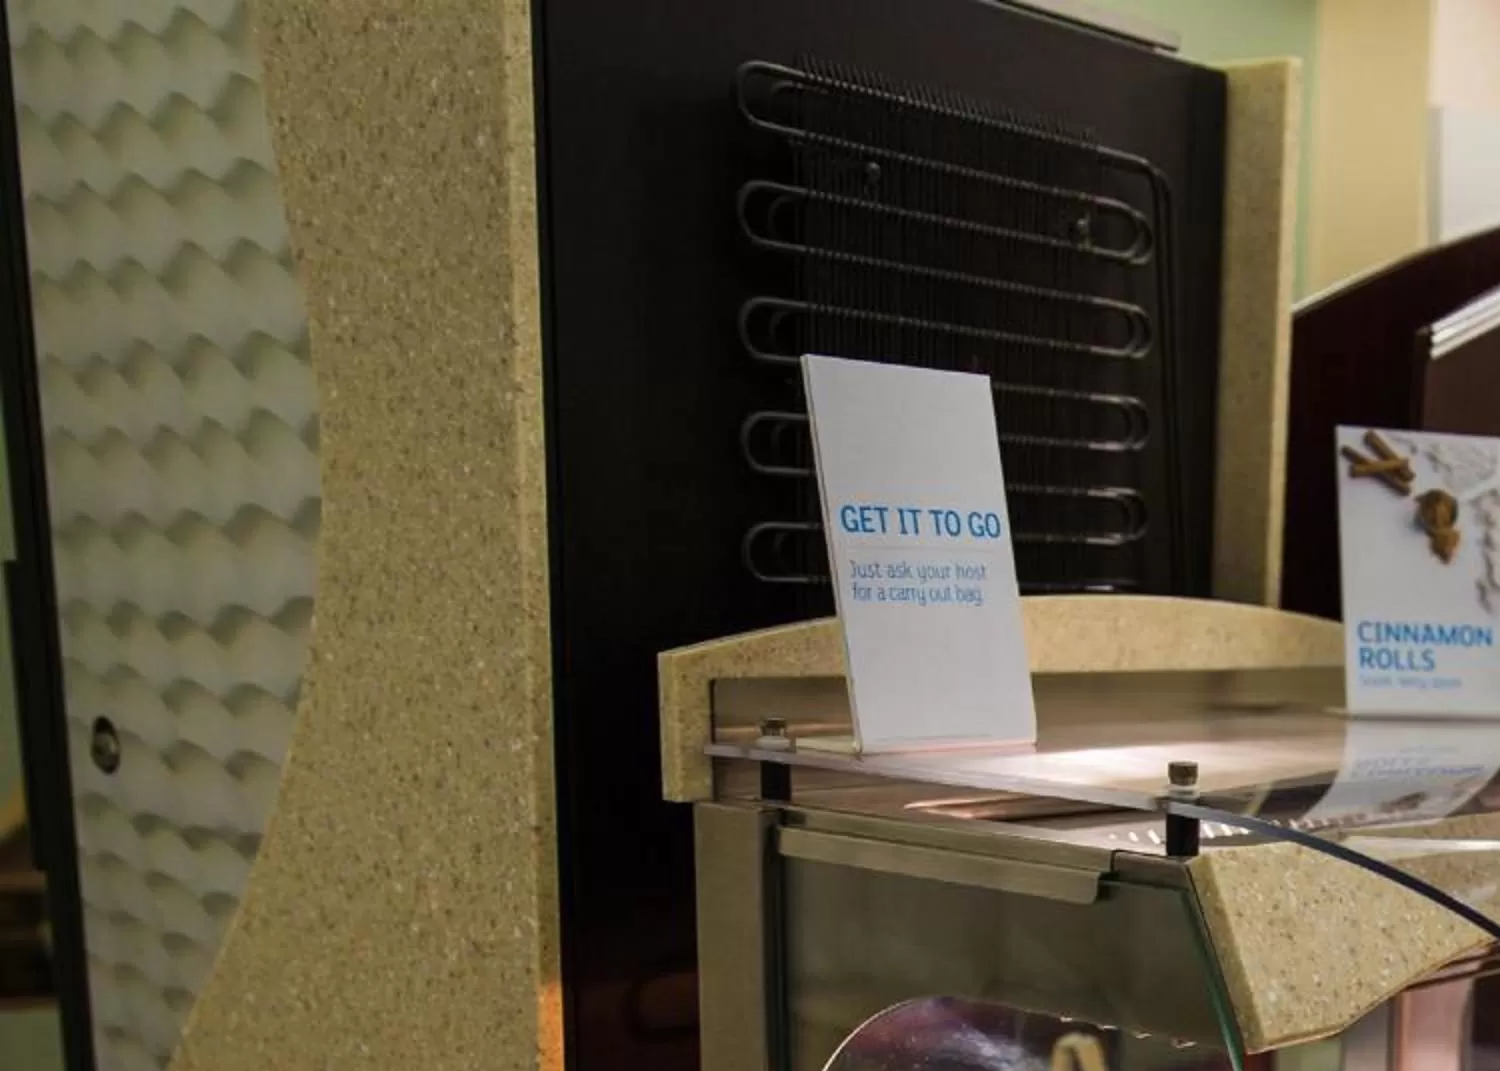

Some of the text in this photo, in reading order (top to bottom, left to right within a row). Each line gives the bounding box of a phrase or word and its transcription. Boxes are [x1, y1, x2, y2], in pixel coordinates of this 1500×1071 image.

[840, 504, 1001, 539] GET IT TO GO
[850, 558, 987, 584] Just ask your host
[851, 582, 984, 607] for a carry out bag
[1357, 620, 1493, 647] CINNAMON
[1359, 647, 1436, 671] ROLLS
